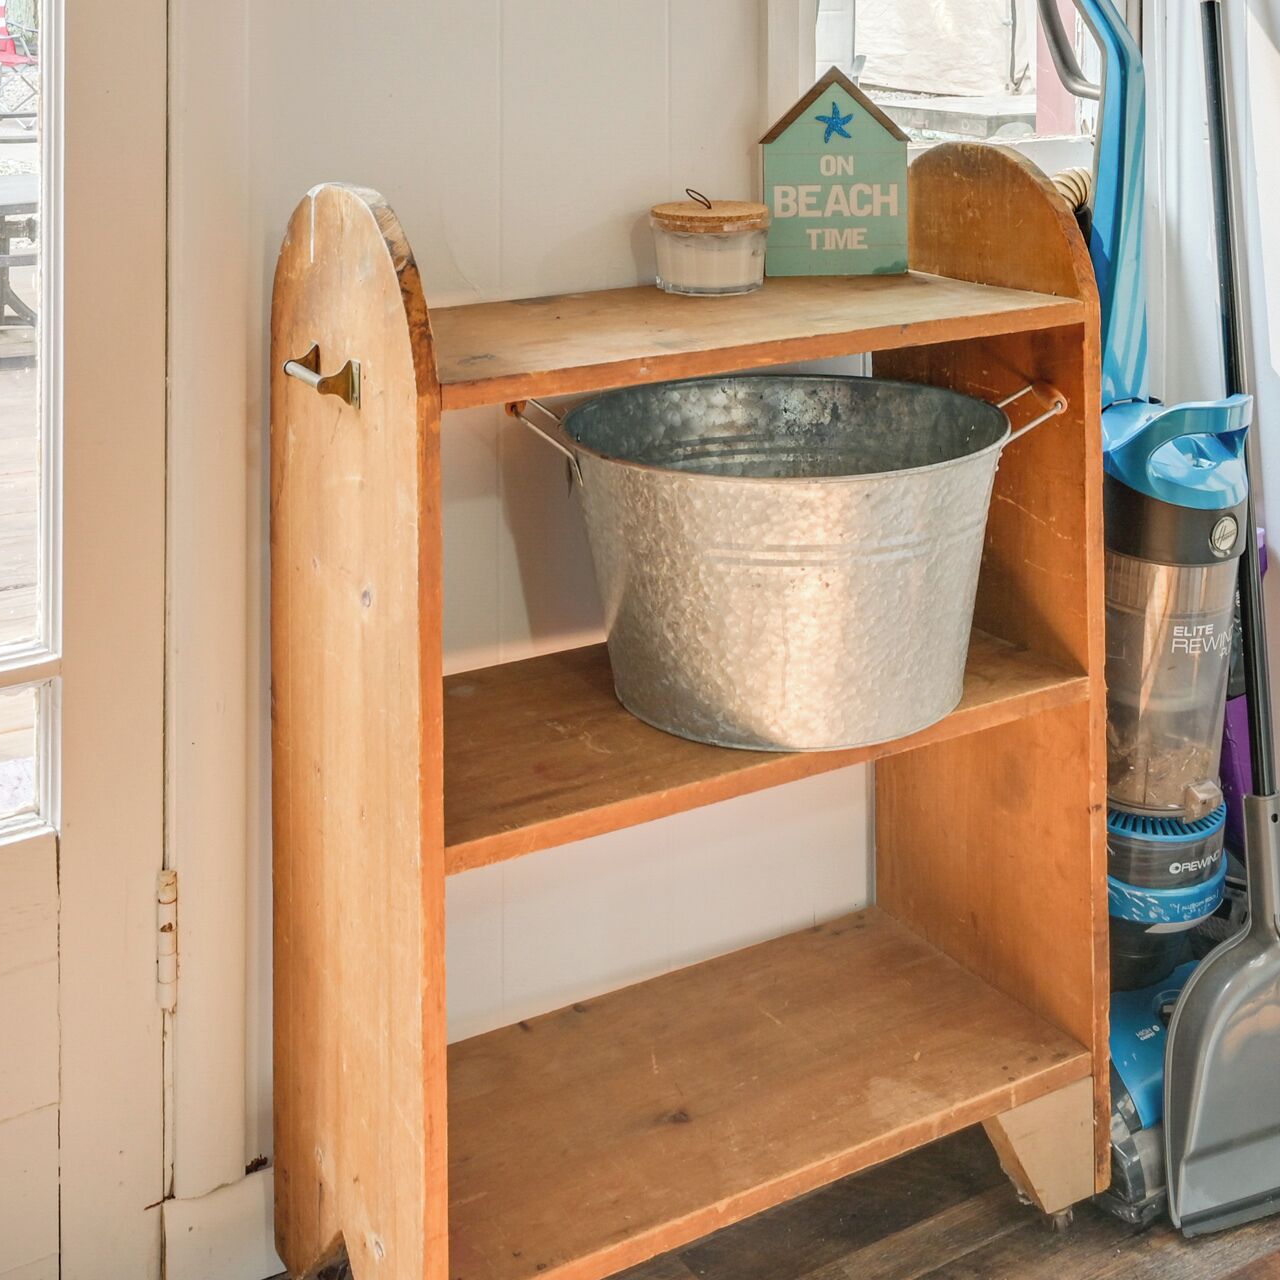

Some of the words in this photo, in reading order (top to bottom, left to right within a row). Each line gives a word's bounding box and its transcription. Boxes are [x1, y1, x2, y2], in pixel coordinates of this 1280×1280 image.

[819, 154, 855, 176] ON
[773, 183, 899, 218] BEACH
[806, 227, 869, 251] TIME
[1173, 624, 1214, 637] ELITE
